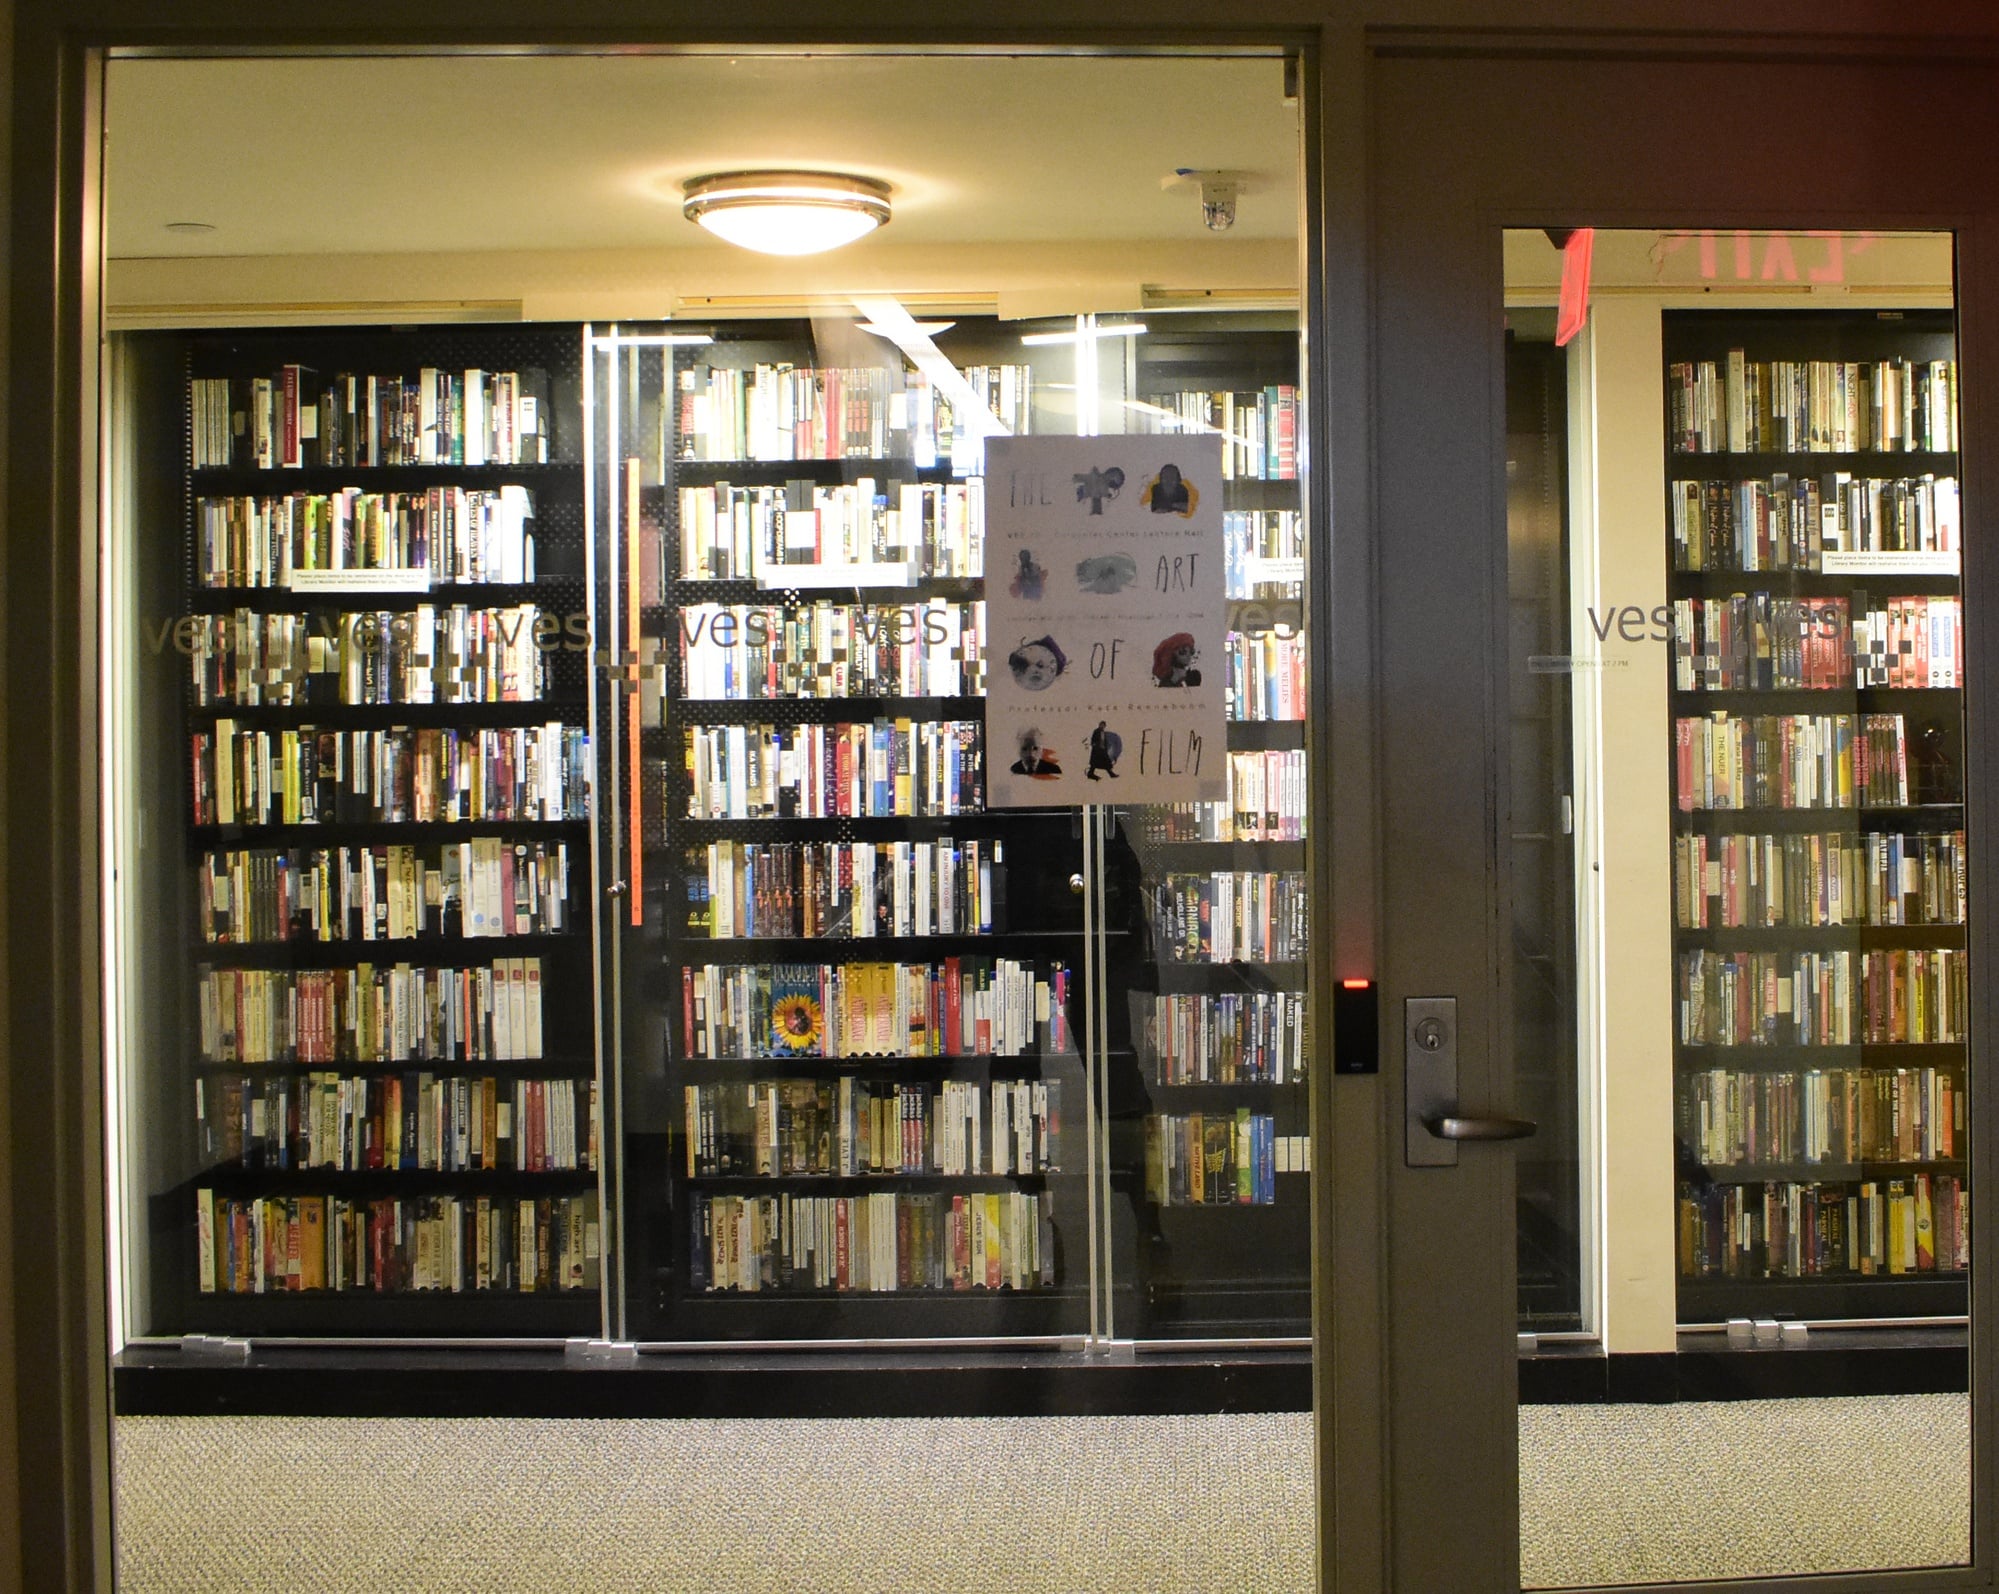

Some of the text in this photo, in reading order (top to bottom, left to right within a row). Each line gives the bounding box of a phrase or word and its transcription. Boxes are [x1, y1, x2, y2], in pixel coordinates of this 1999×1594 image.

[1010, 472, 1053, 507] THE
[1155, 553, 1200, 592] ART
[143, 614, 235, 655] ves
[319, 613, 415, 654] ves
[491, 612, 592, 652] ves
[681, 610, 769, 648] ves
[856, 607, 948, 645] ves
[1588, 604, 1676, 642] ves
[1758, 603, 1842, 641] ves
[1090, 639, 1125, 680] OF
[1139, 728, 1202, 777] FILM
